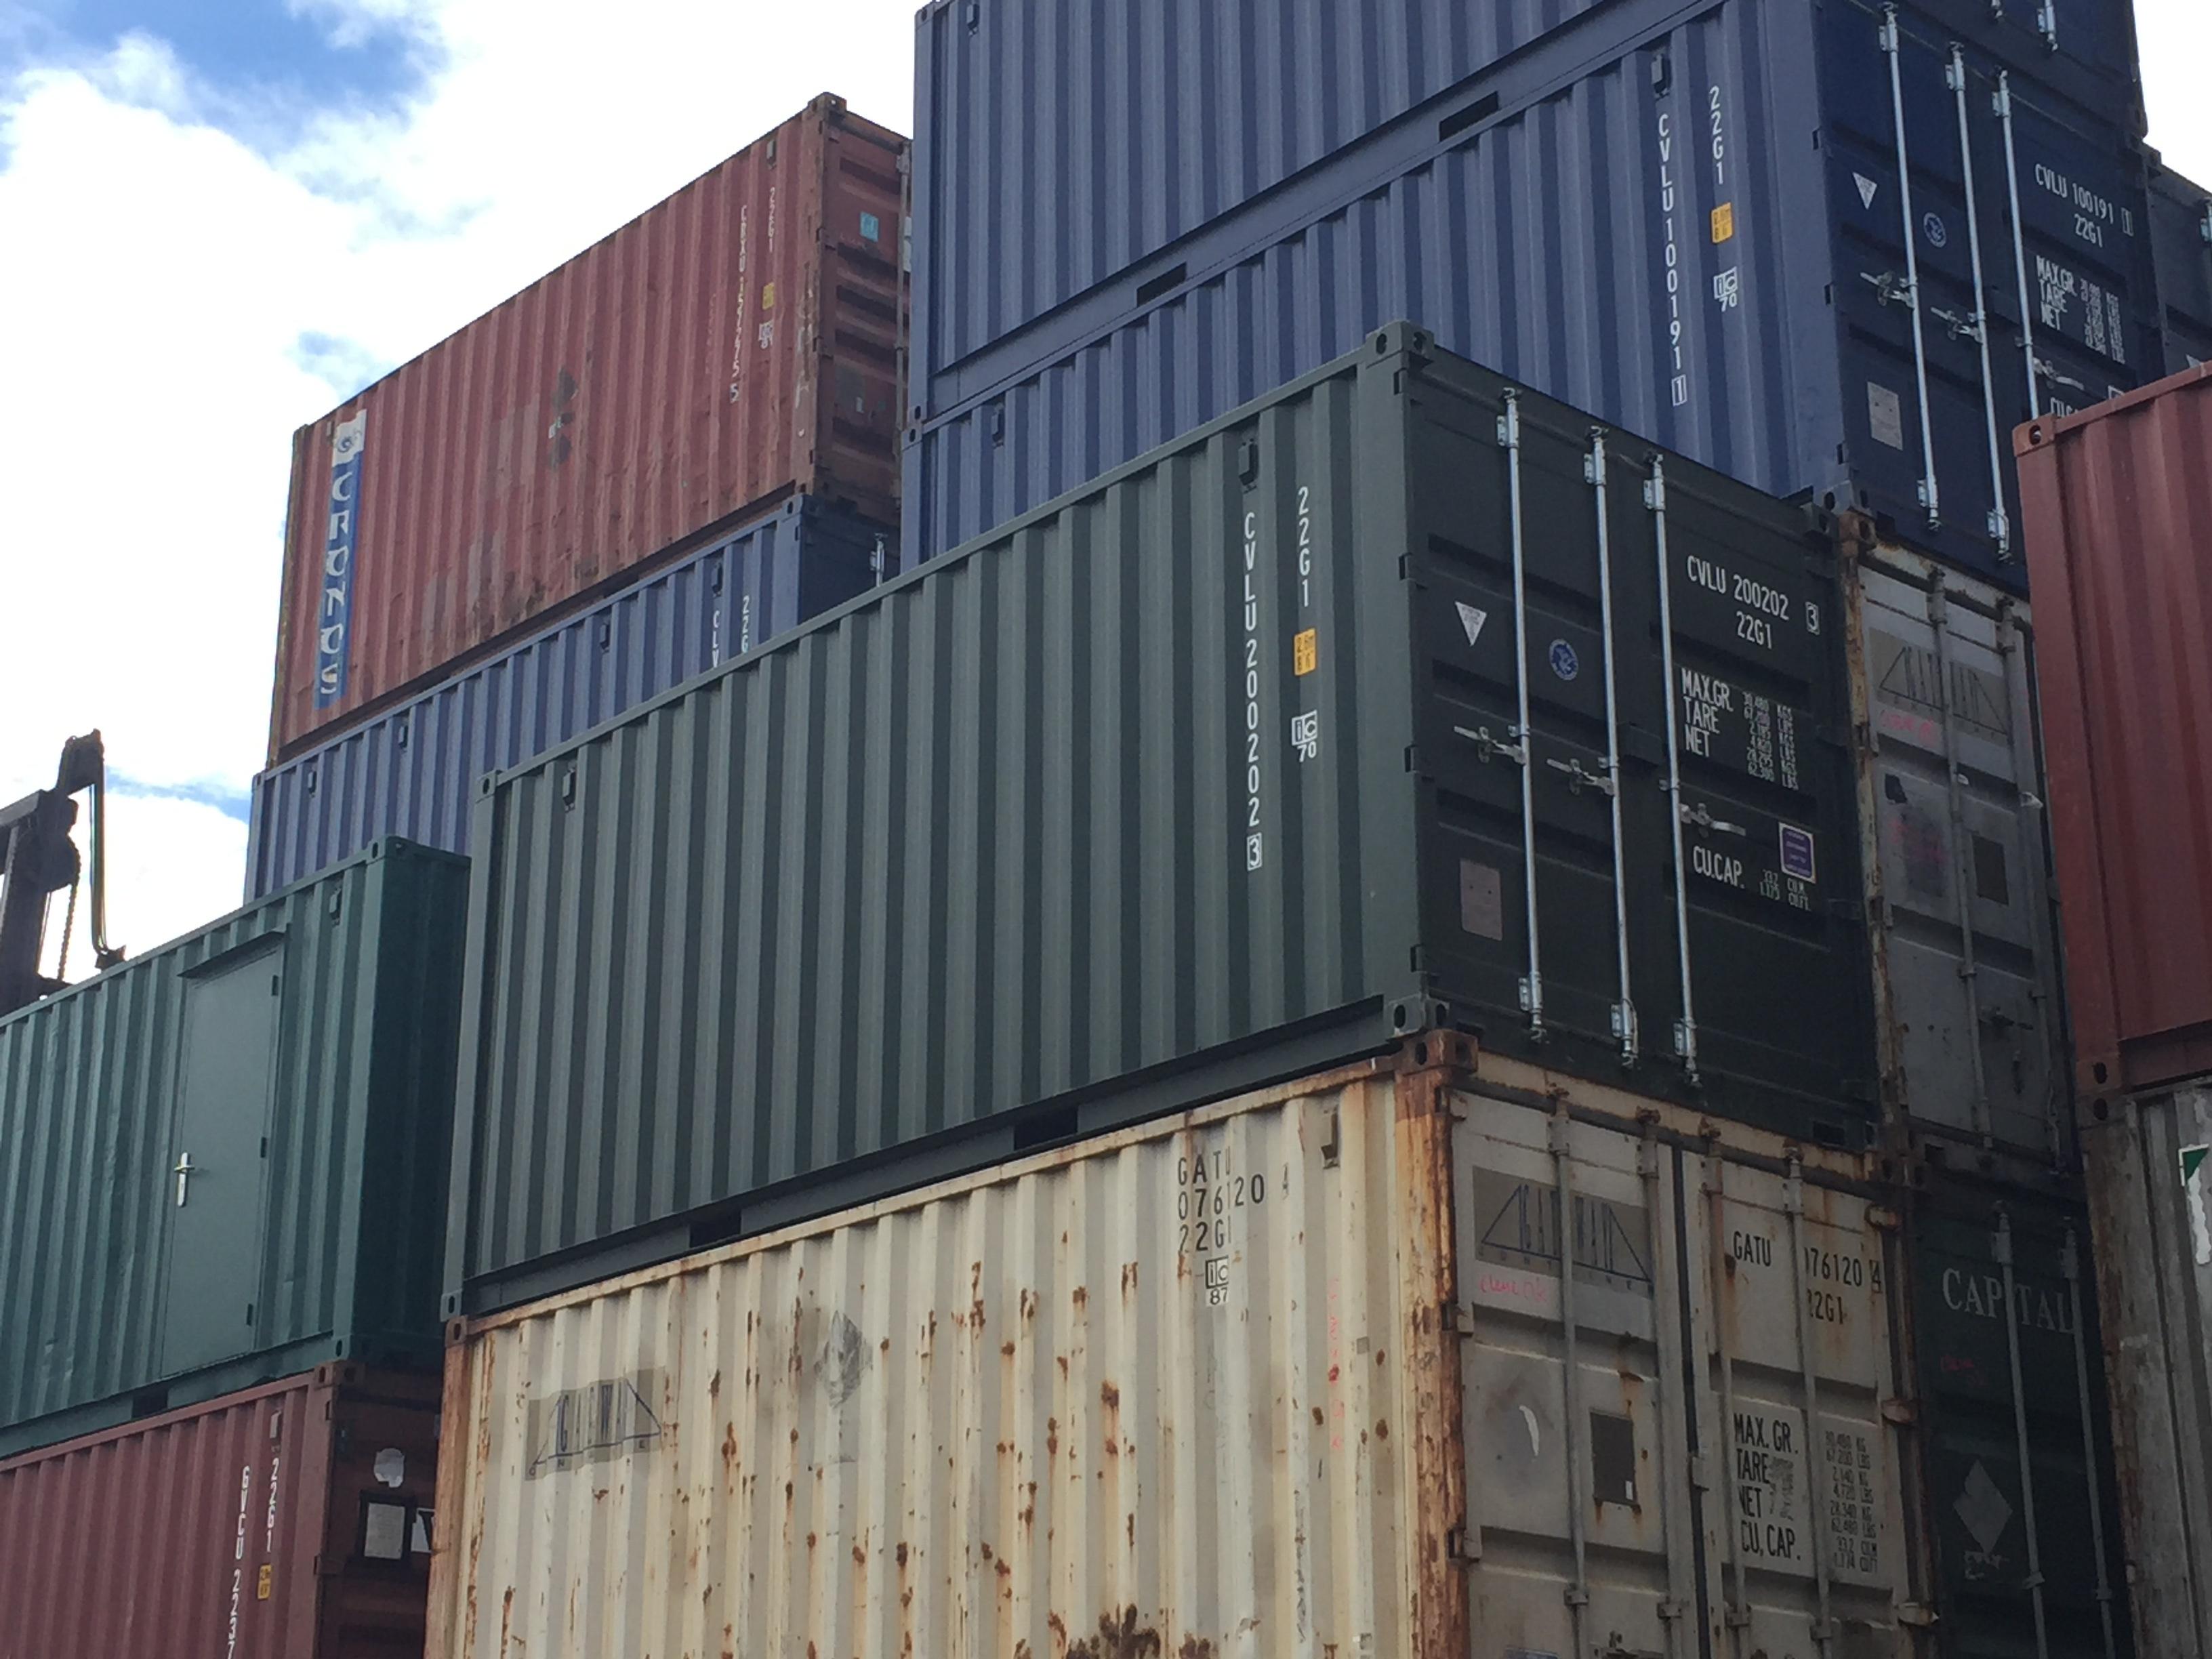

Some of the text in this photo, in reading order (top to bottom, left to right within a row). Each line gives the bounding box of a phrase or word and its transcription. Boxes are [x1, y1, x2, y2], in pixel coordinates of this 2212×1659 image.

[1710, 85, 1724, 185] 22G1
[2035, 164, 2068, 198] CVLU
[2072, 184, 2114, 224] 100191
[2074, 213, 2103, 247] 22G1
[1719, 292, 1738, 312] 70
[2040, 279, 2068, 313] TARE
[2041, 301, 2061, 331] NET
[1298, 487, 1311, 607] 22G1
[1687, 555, 1726, 594] CVLU
[1734, 574, 1789, 620] 200202
[1736, 611, 1771, 649] 22G1
[1683, 695, 1720, 734] TARE
[1297, 740, 1317, 762] 70
[1685, 724, 1709, 757] NET
[1178, 1146, 1231, 1185] GATU
[1733, 1231, 1771, 1267] GATU
[1210, 1288, 1229, 1305] 87
[1942, 1267, 2074, 1334] CAPTAL
[1736, 1448, 1770, 1484] TARE
[235, 1465, 249, 1560] GVCU
[266, 1458, 279, 1553] 22G1
[1767, 1524, 1801, 1561] CAP.
